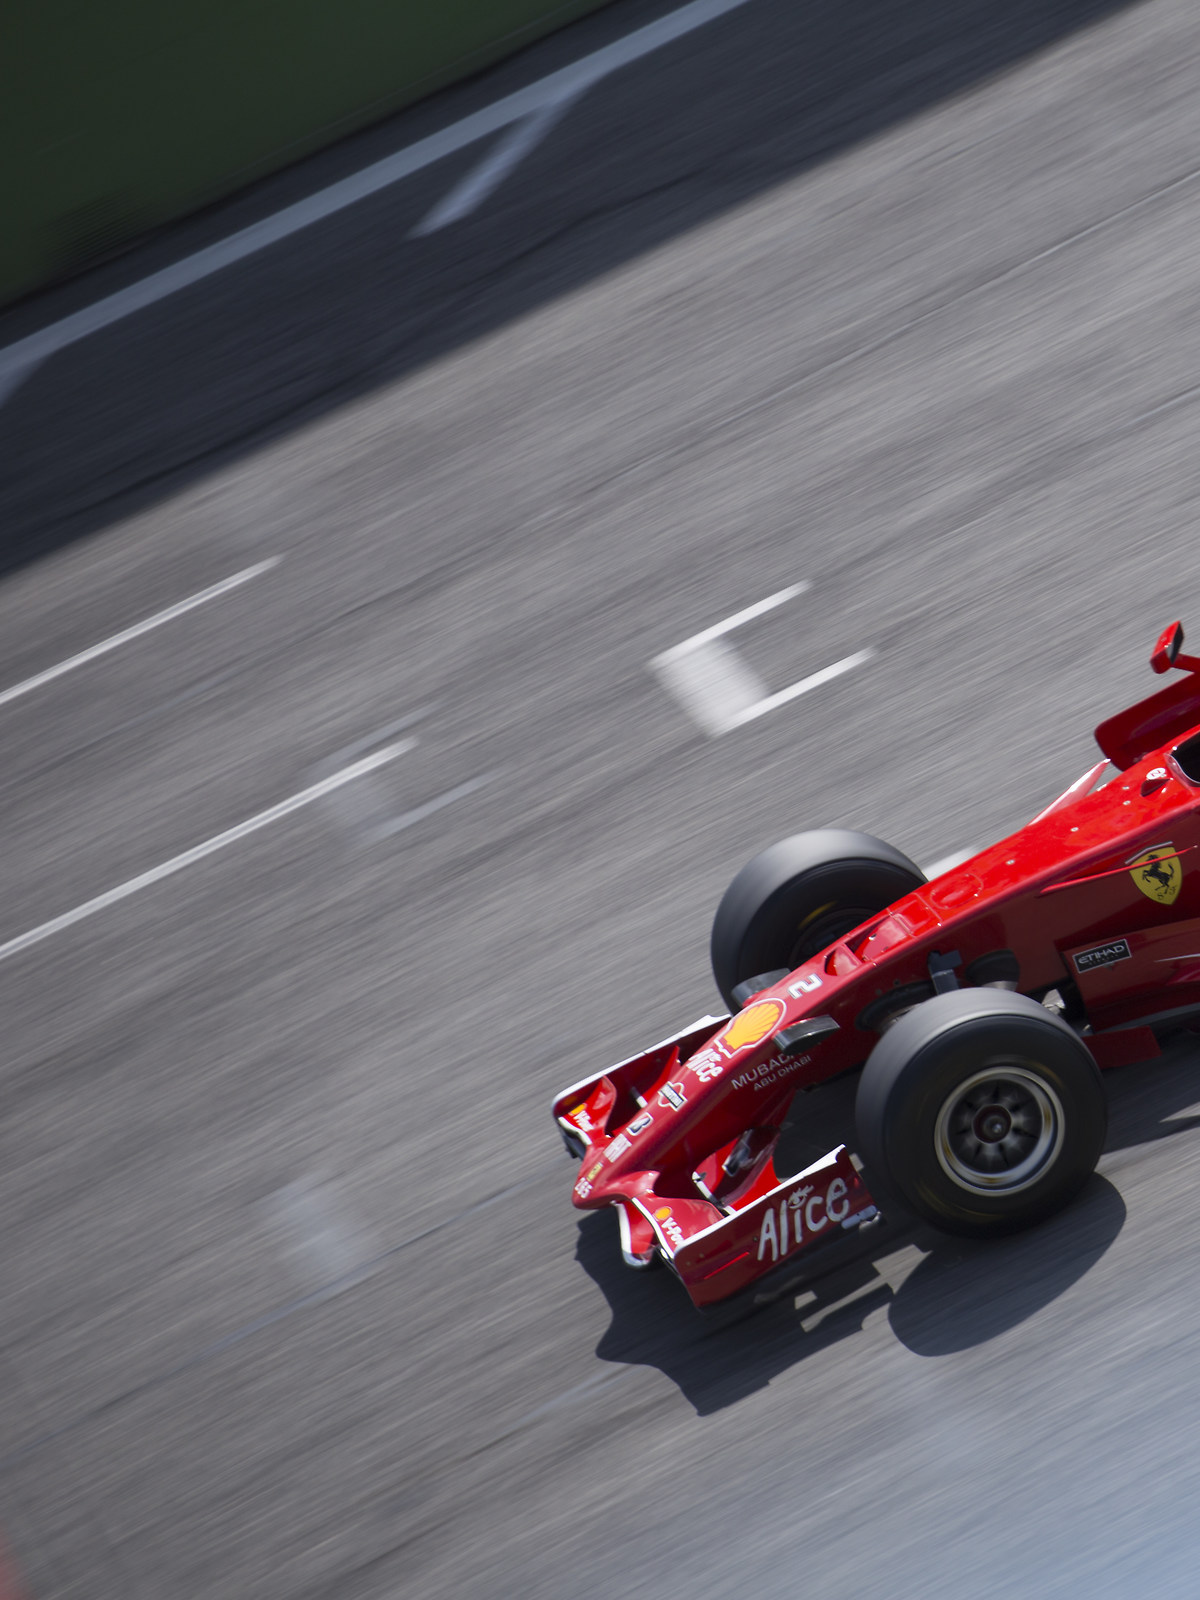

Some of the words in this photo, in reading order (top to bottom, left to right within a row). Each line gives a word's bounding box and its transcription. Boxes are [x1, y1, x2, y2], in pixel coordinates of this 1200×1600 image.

[1078, 945, 1125, 964] ETIHAD
[787, 973, 823, 999] 2
[686, 1048, 724, 1082] Alice
[731, 1052, 795, 1090] MUBAD
[754, 1072, 777, 1091] ABU
[779, 1055, 811, 1078] DHABI
[757, 1177, 850, 1261] Alice
